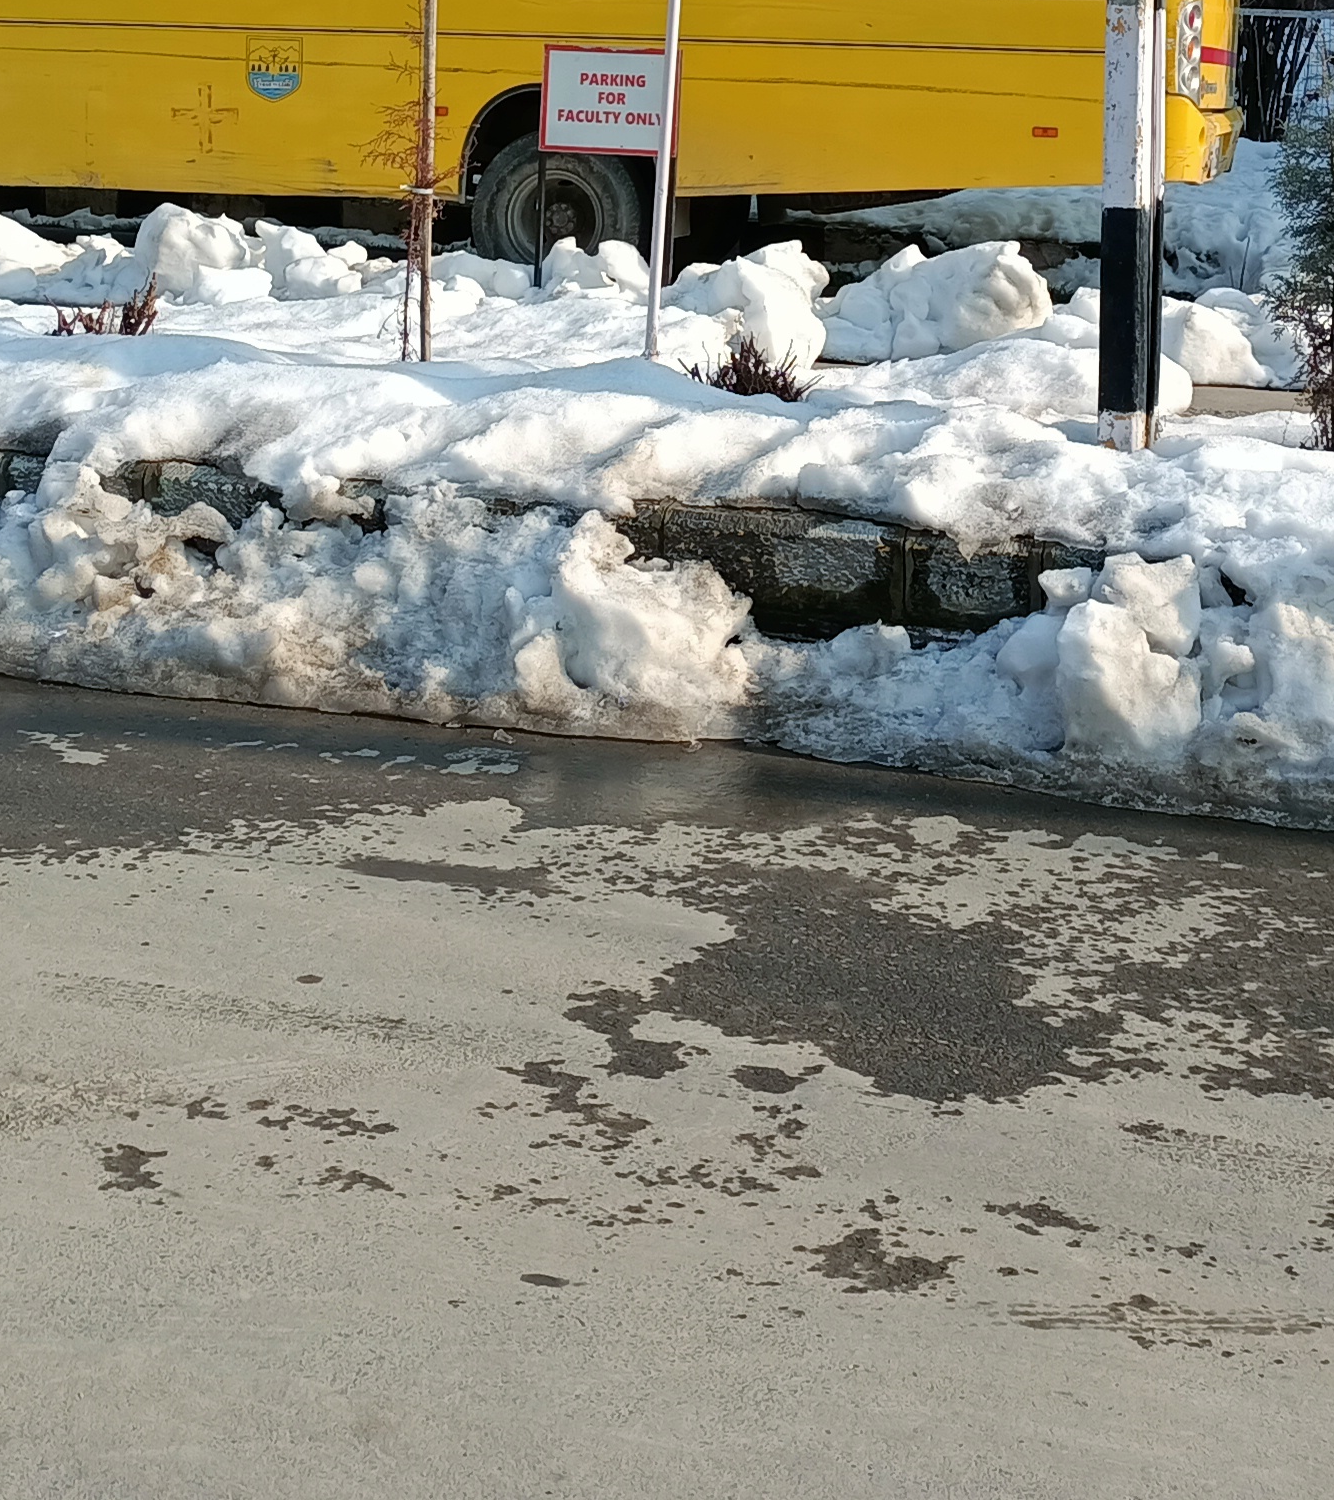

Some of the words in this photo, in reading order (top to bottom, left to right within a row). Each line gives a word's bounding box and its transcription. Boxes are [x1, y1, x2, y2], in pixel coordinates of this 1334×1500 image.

[580, 72, 646, 88] PARKING
[597, 91, 626, 105] FOR
[557, 108, 622, 124] FACULTY
